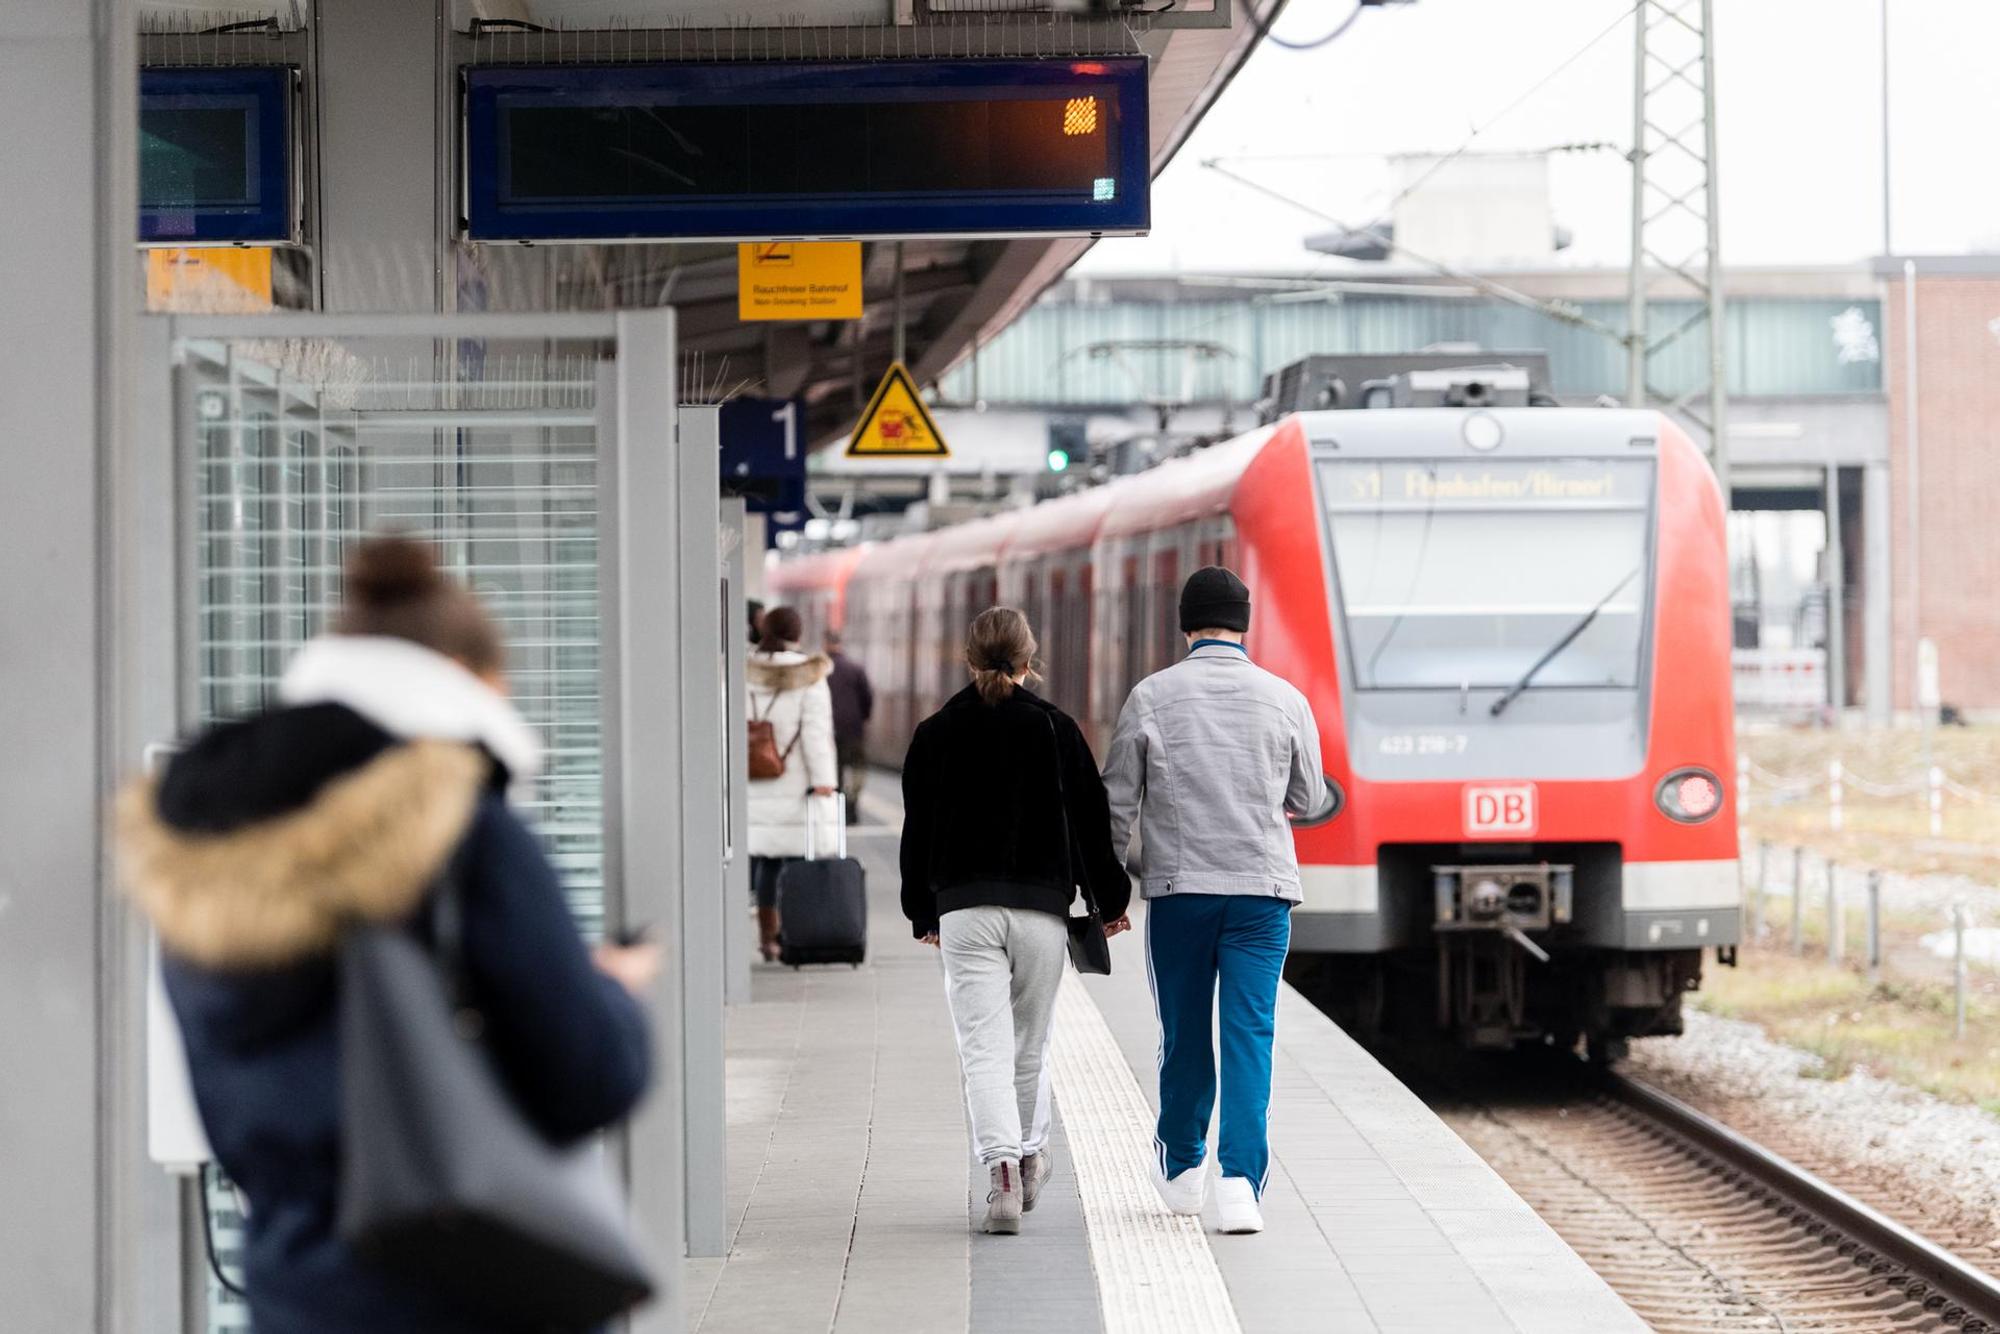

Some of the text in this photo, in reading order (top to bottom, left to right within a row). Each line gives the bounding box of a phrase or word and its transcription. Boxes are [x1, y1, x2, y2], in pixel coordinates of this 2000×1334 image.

[808, 283, 848, 293] Bahnhof
[772, 402, 796, 459] 1
[1475, 793, 1526, 826] DB
